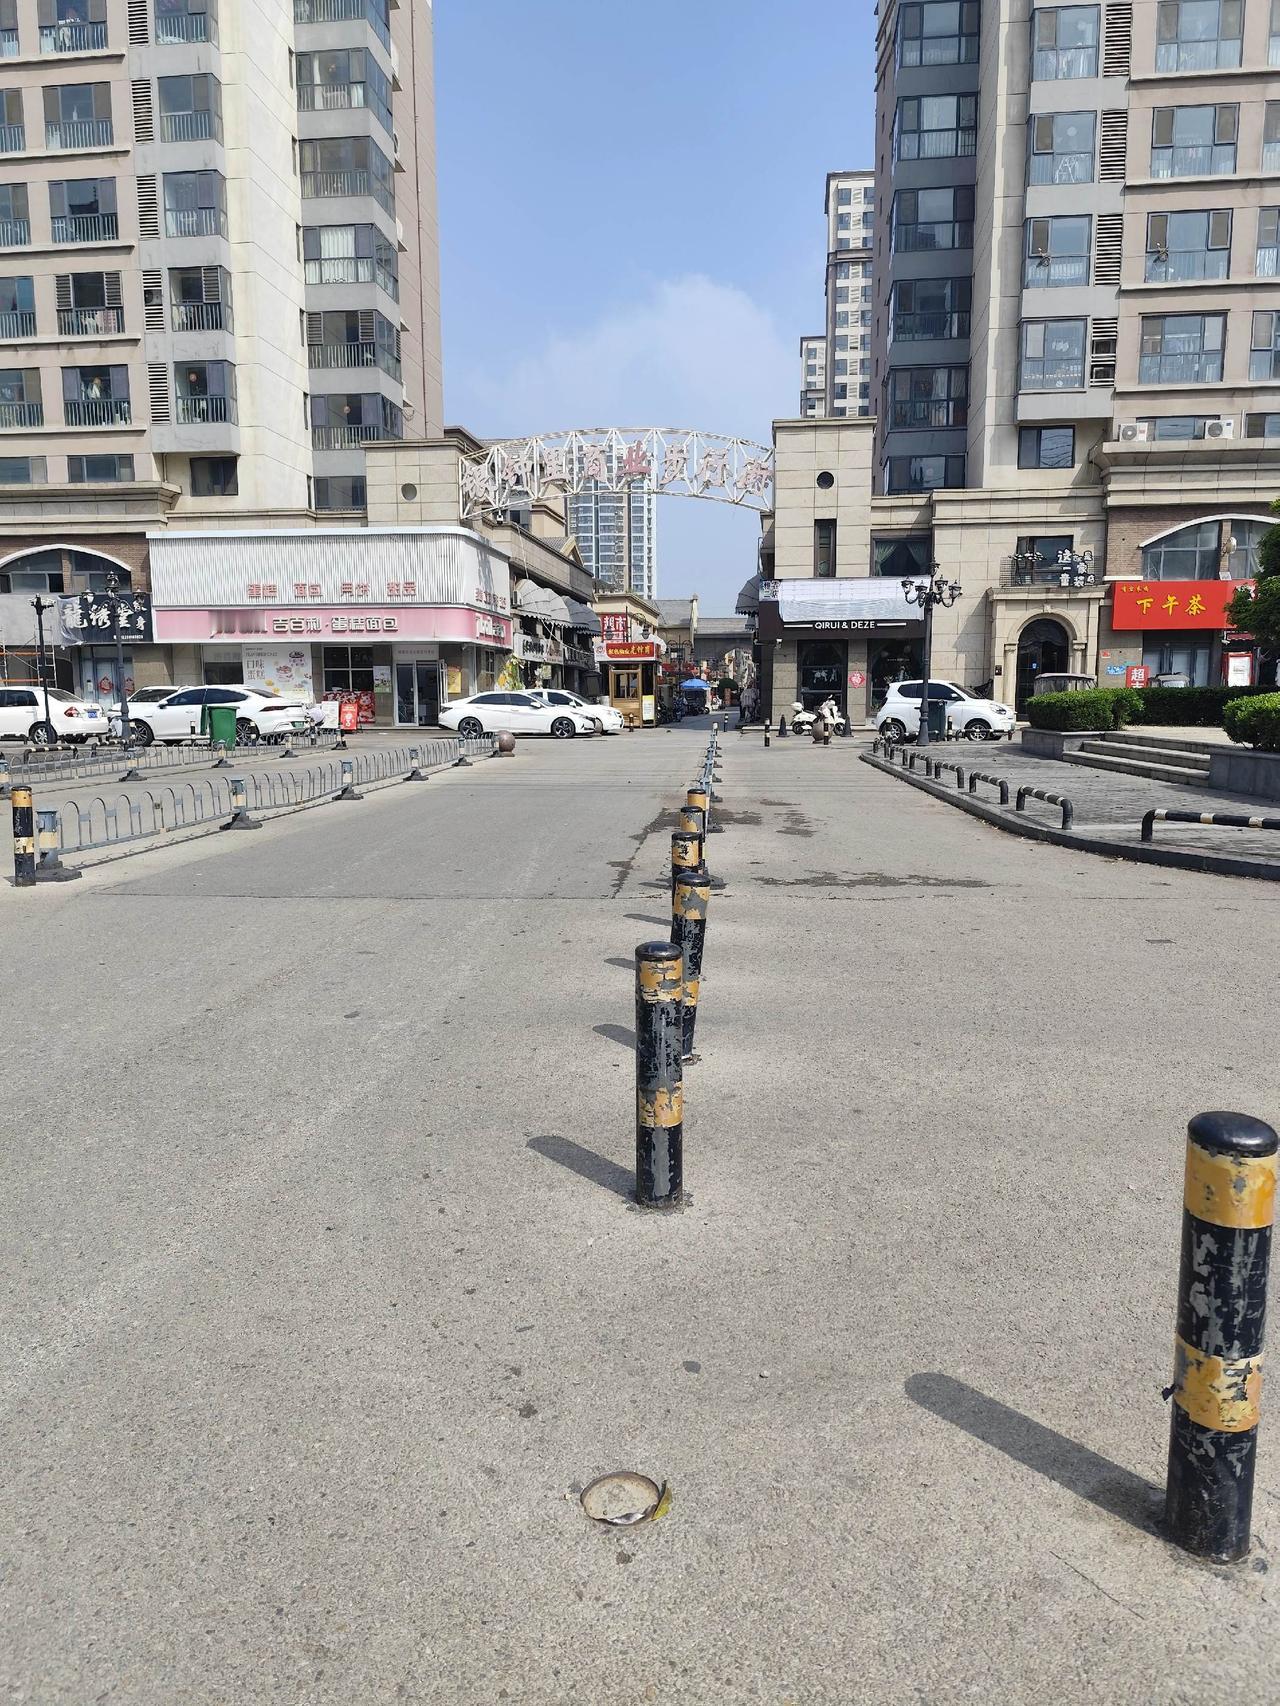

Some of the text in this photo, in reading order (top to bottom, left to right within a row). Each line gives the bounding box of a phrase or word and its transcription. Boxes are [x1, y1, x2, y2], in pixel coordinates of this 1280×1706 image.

[293, 583, 323, 597] 面包
[340, 582, 370, 597] 月饼
[1136, 594, 1207, 616] 下午茶
[814, 621, 875, 630] QIRUI & DEZE
